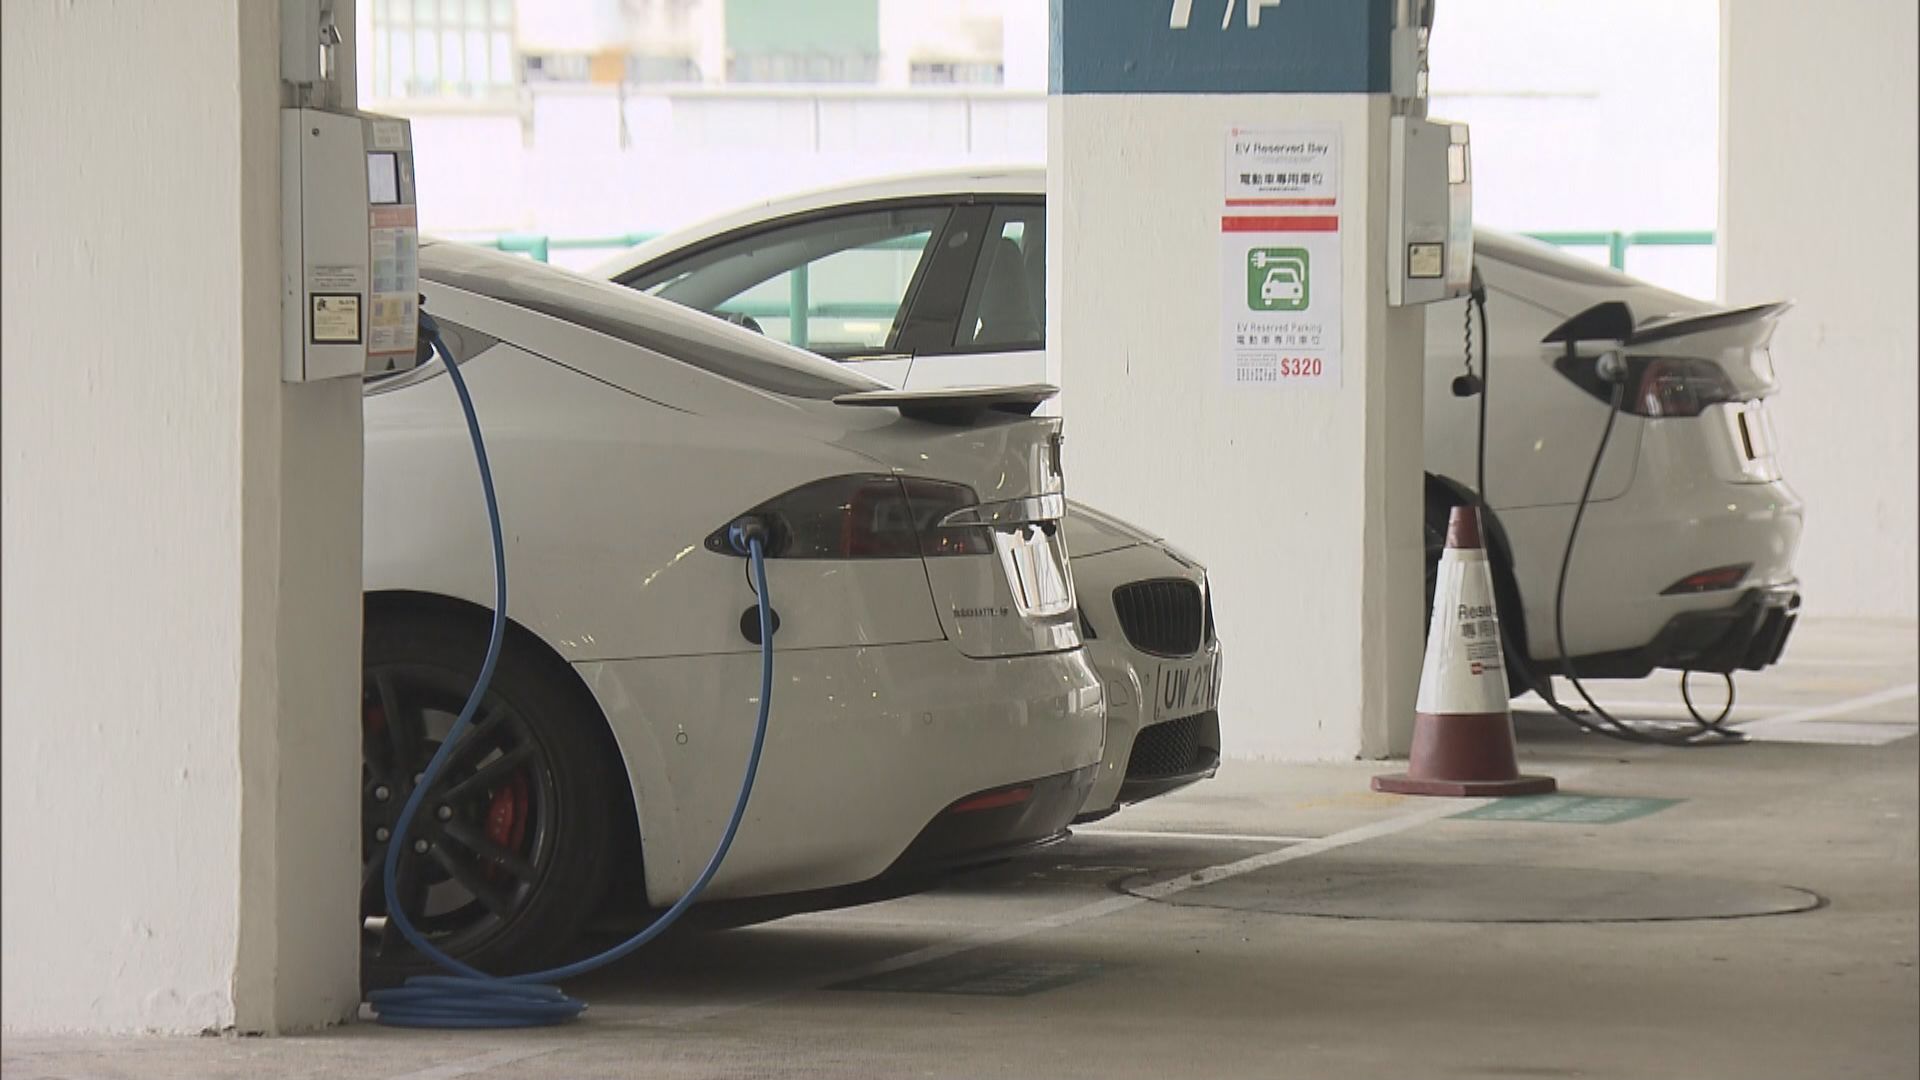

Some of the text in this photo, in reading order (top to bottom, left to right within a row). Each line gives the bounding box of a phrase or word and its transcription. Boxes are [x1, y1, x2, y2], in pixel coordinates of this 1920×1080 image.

[1234, 143, 1328, 156] EV Reserved Bay
[1236, 323, 1322, 334] EV Reserved Parking
[1281, 358, 1322, 377] $320
[1165, 667, 1190, 709] UW
